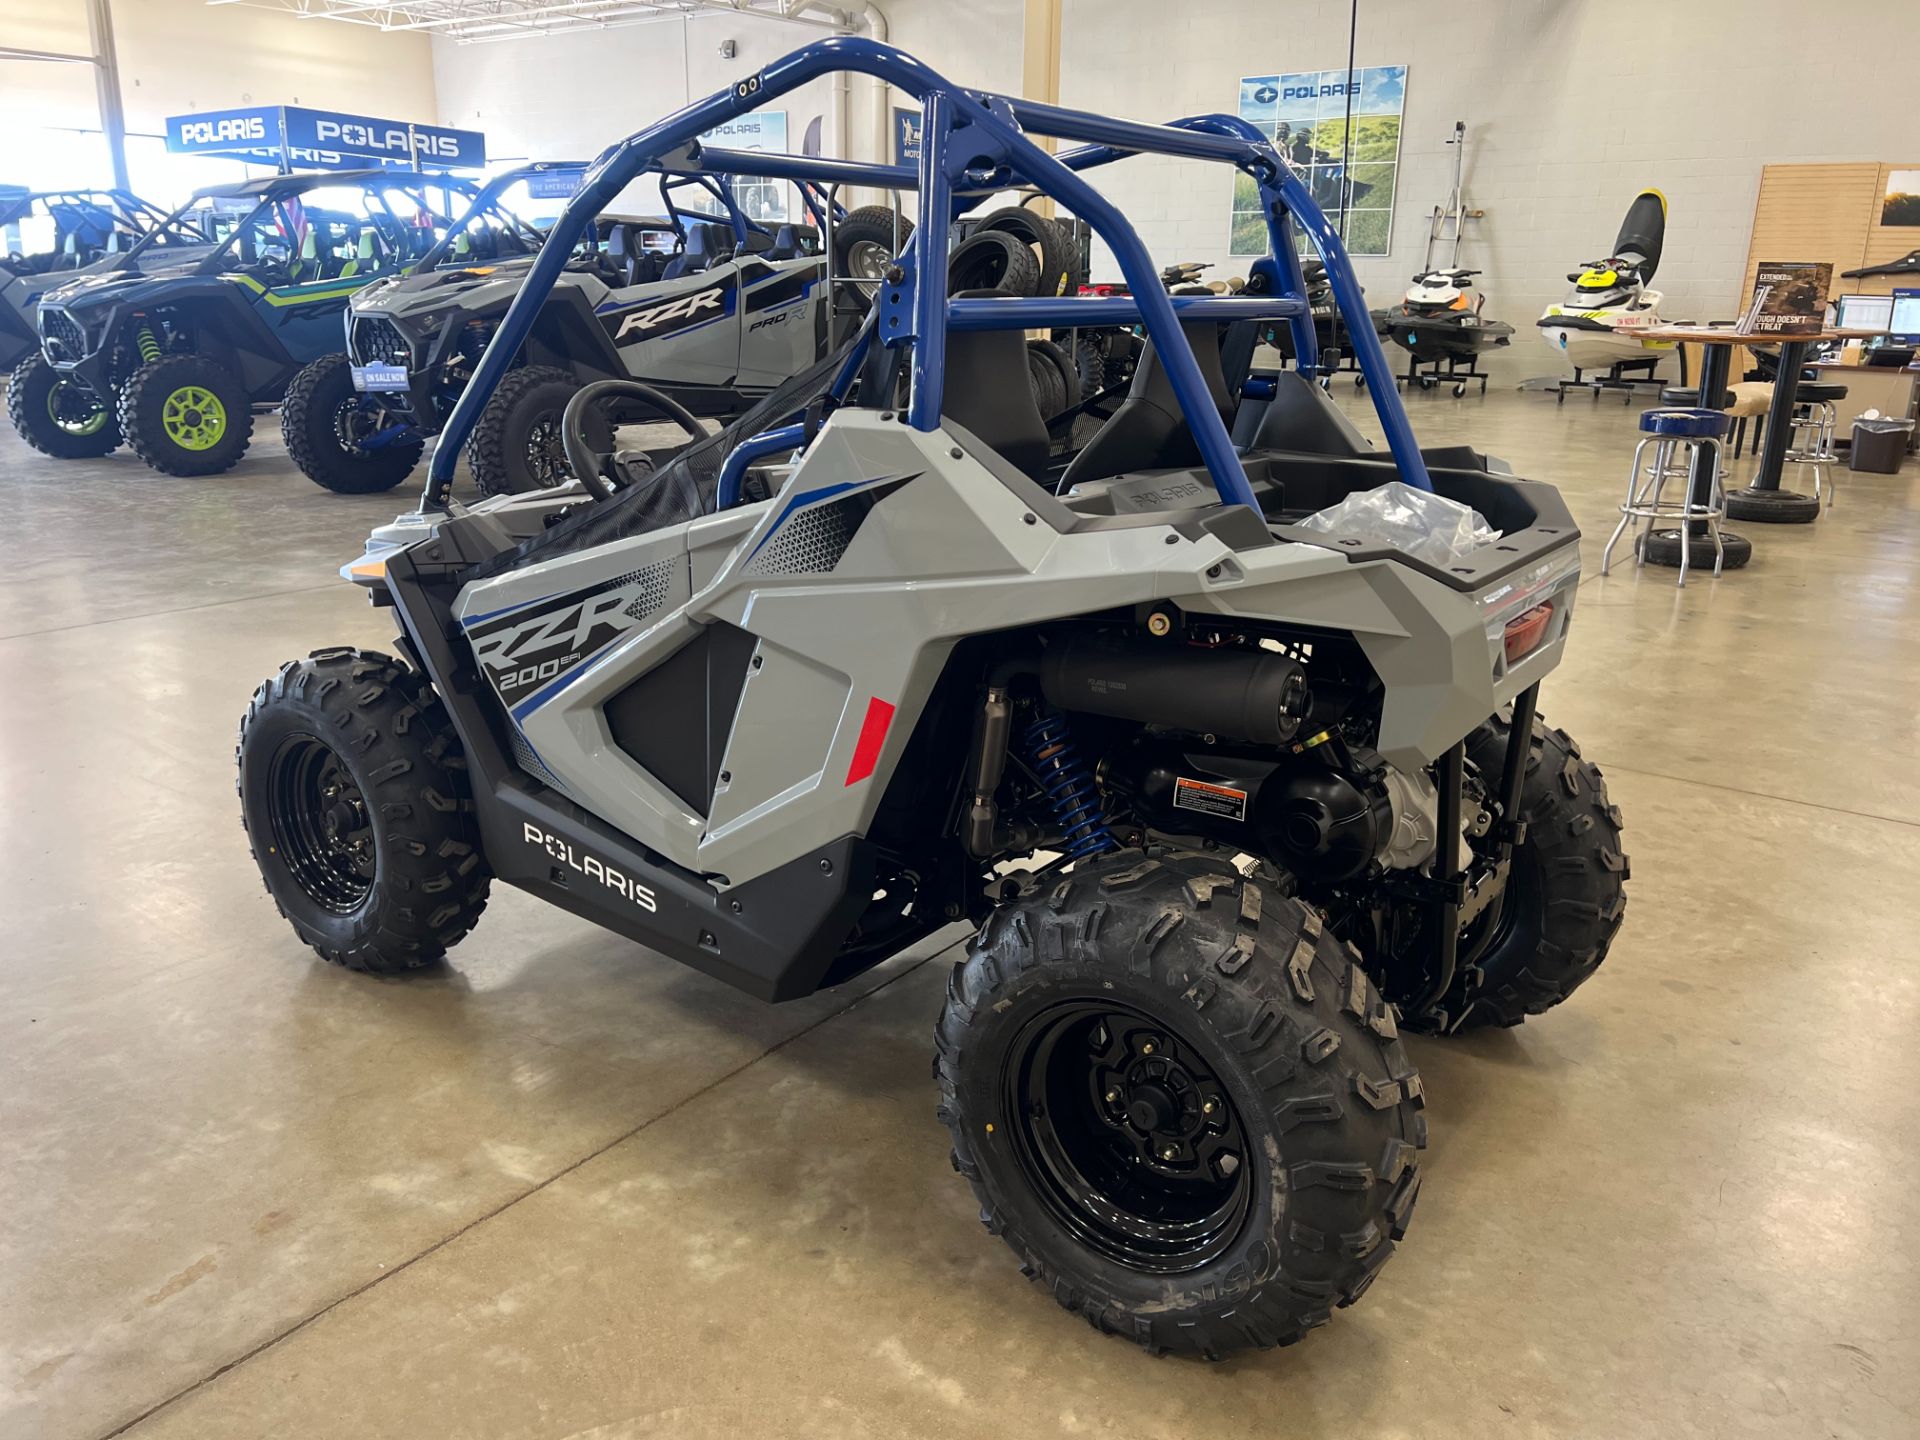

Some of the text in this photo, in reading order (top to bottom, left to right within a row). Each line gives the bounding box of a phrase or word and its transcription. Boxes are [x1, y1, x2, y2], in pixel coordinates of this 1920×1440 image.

[1283, 82, 1362, 100] POLARIS
[181, 117, 265, 144] POLARIS
[315, 120, 460, 157] POLARIS
[715, 123, 761, 136] POLARIS
[615, 287, 723, 340] RZR
[749, 310, 787, 333] PRO
[1753, 323, 1783, 331] ETREAT
[1756, 315, 1807, 324] OUGH DOESN'T
[471, 582, 646, 673] RZR
[500, 652, 581, 691] 200 EFI
[523, 822, 657, 913] POLARIS
